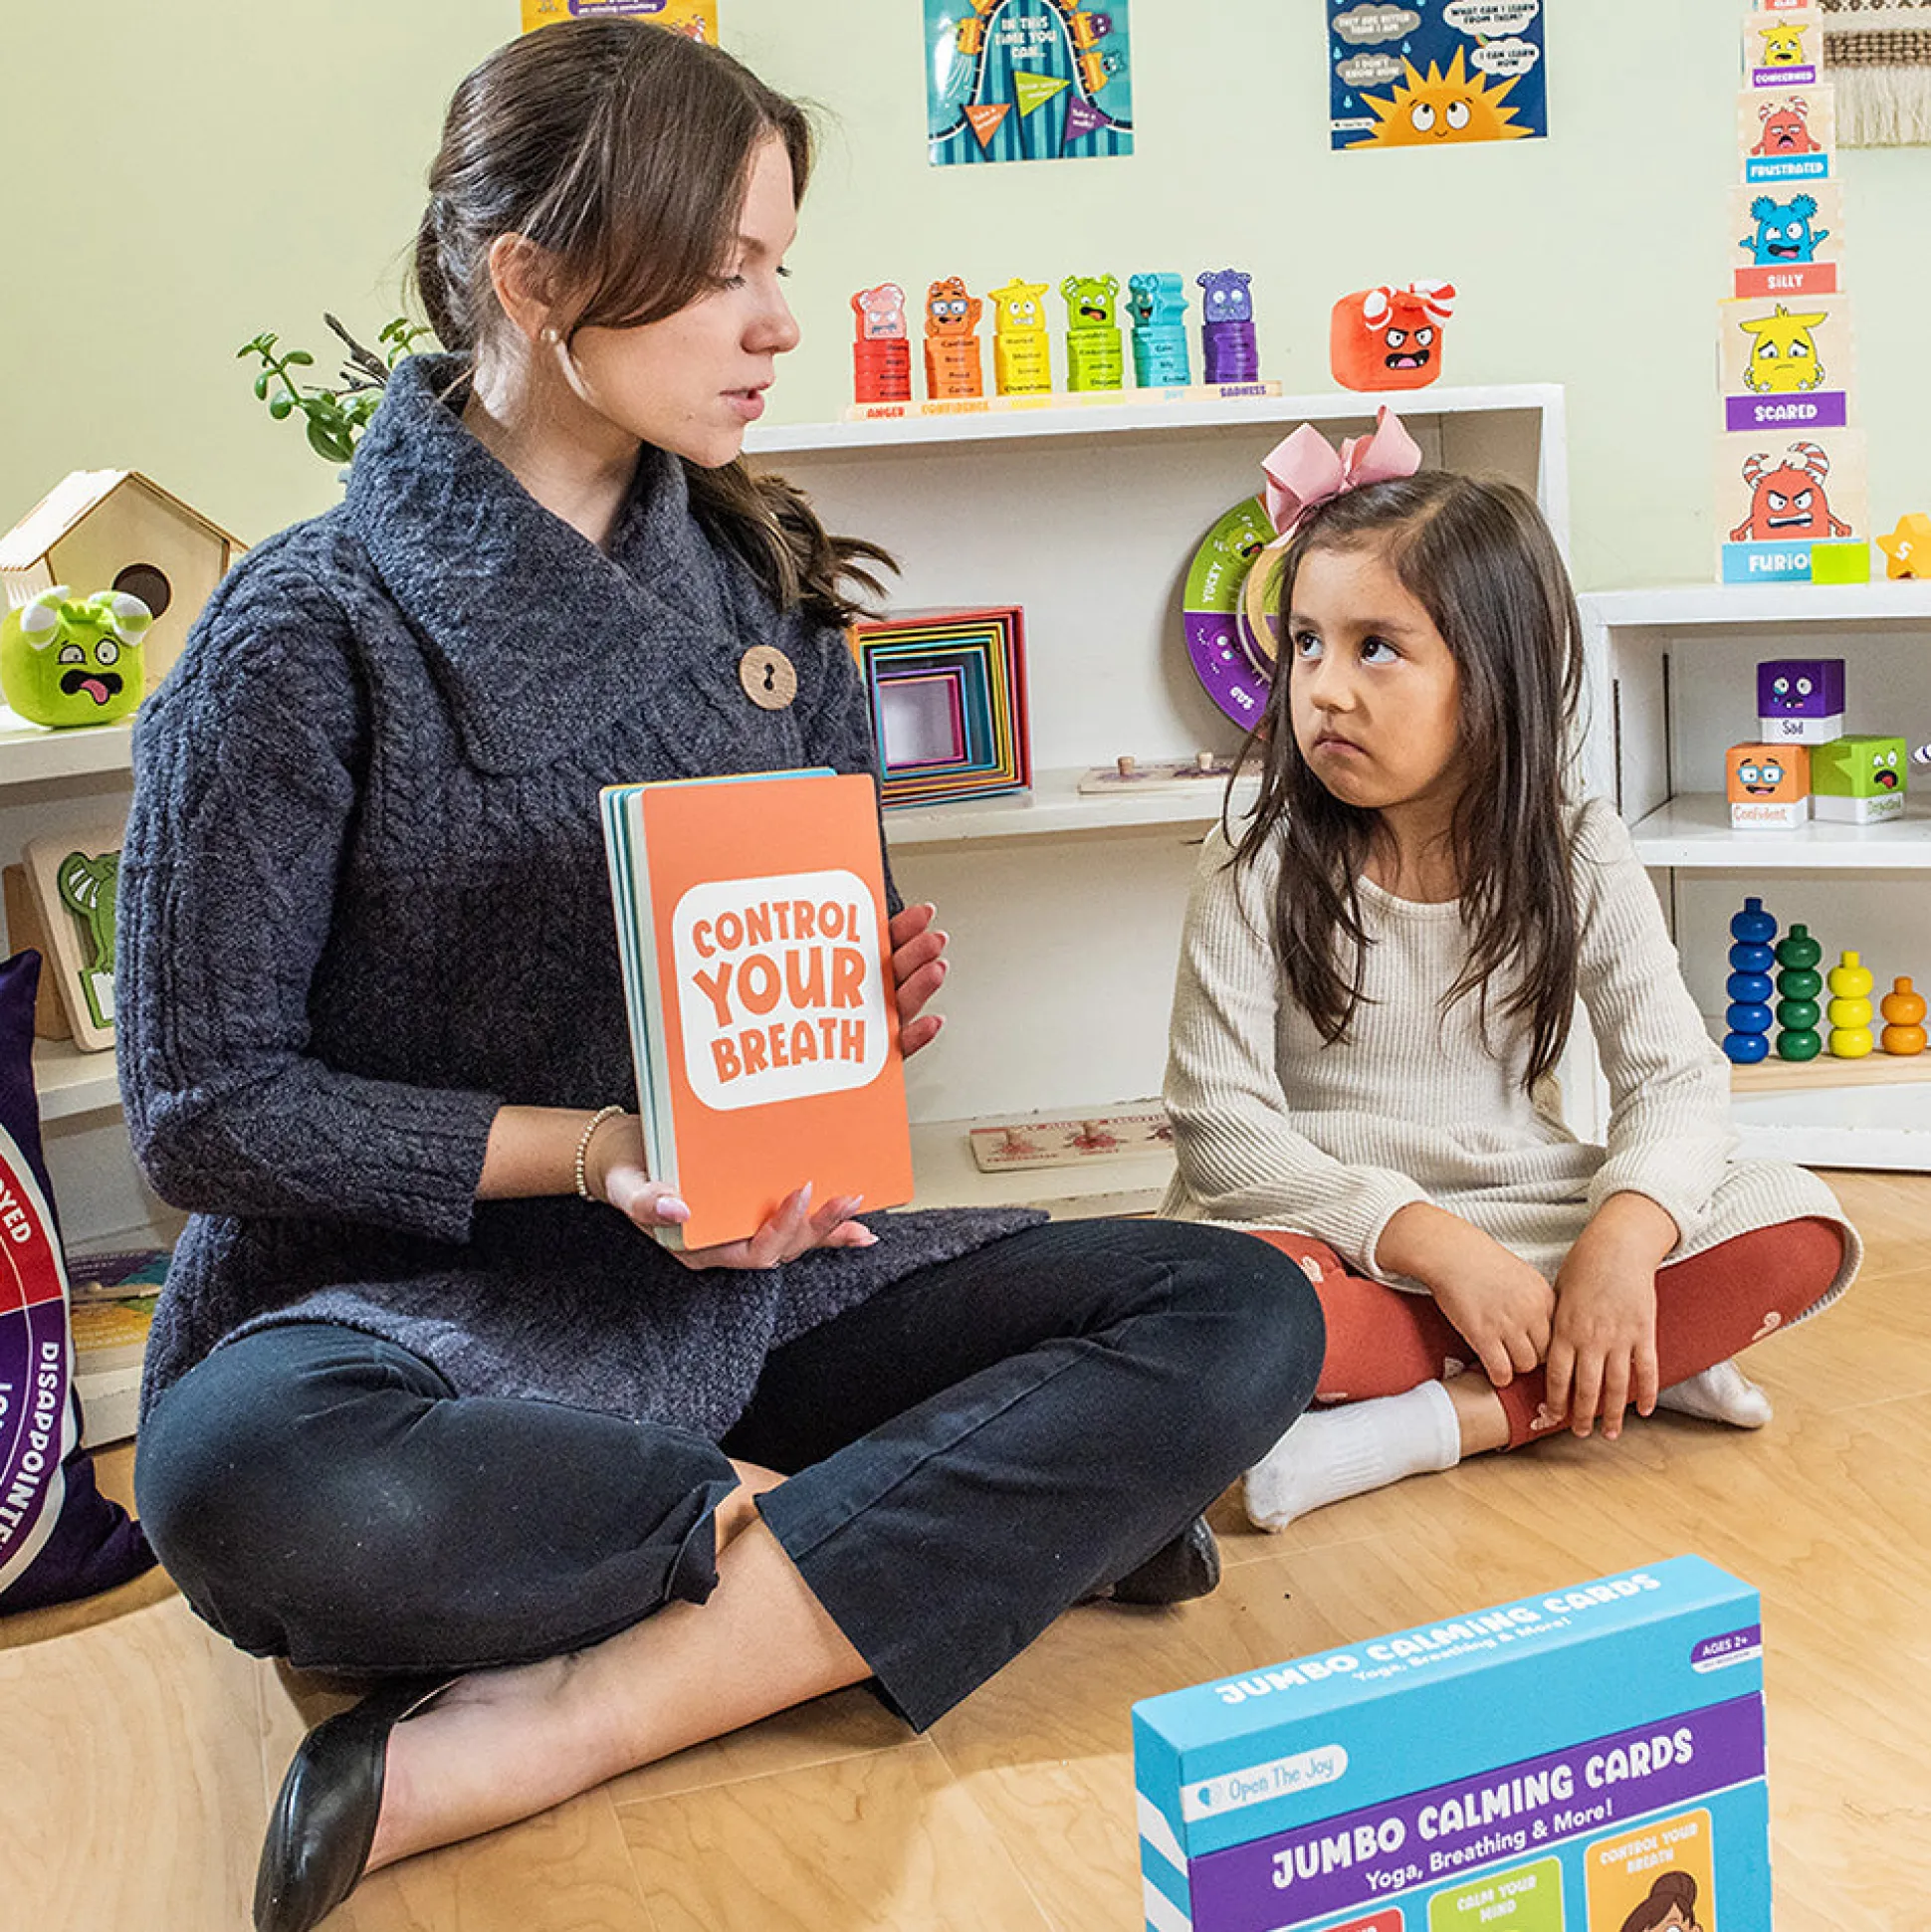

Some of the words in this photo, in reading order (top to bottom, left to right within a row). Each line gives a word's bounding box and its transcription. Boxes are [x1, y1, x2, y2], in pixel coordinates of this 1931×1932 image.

[1029, 30, 1058, 43] YOU
[1750, 161, 1824, 177] FRUSTRATED
[1767, 274, 1804, 290] SILLY
[866, 406, 905, 419] ANGER
[1219, 384, 1267, 398] SADNESS
[1753, 402, 1818, 422] SCARED
[1748, 552, 1812, 572] FURIO
[1782, 719, 1804, 737] Sad
[692, 899, 861, 960] CONTROL
[692, 945, 867, 1029] YOUR
[710, 1015, 866, 1085] BREATH
[0, 1179, 32, 1243] YED
[1214, 1653, 1360, 1705] JUMBO
[1366, 1607, 1542, 1661] CALMING
[1543, 1573, 1661, 1613] CARDS
[1406, 1637, 1499, 1667] Breathing
[1702, 1637, 1733, 1656] AGES
[1734, 1634, 1749, 1648] 2+
[1228, 1777, 1270, 1803] Open
[1272, 1764, 1301, 1790] The
[1305, 1756, 1336, 1780] Joy
[1272, 1817, 1406, 1889] JUMBO
[1417, 1764, 1576, 1841] CALMING
[1585, 1727, 1694, 1789] CARDS
[1365, 1863, 1424, 1892] Yoga,
[1429, 1828, 1527, 1872] Breathing
[1531, 1819, 1549, 1839] &
[1554, 1797, 1614, 1833] More!
[1599, 1834, 1658, 1866] CONTROL
[1660, 1822, 1700, 1844] YOUR
[1625, 1846, 1674, 1874] BREATH
[1455, 1886, 1495, 1912] CALM
[1497, 1874, 1538, 1897] YOUR
[1478, 1898, 1518, 1923] MIND
